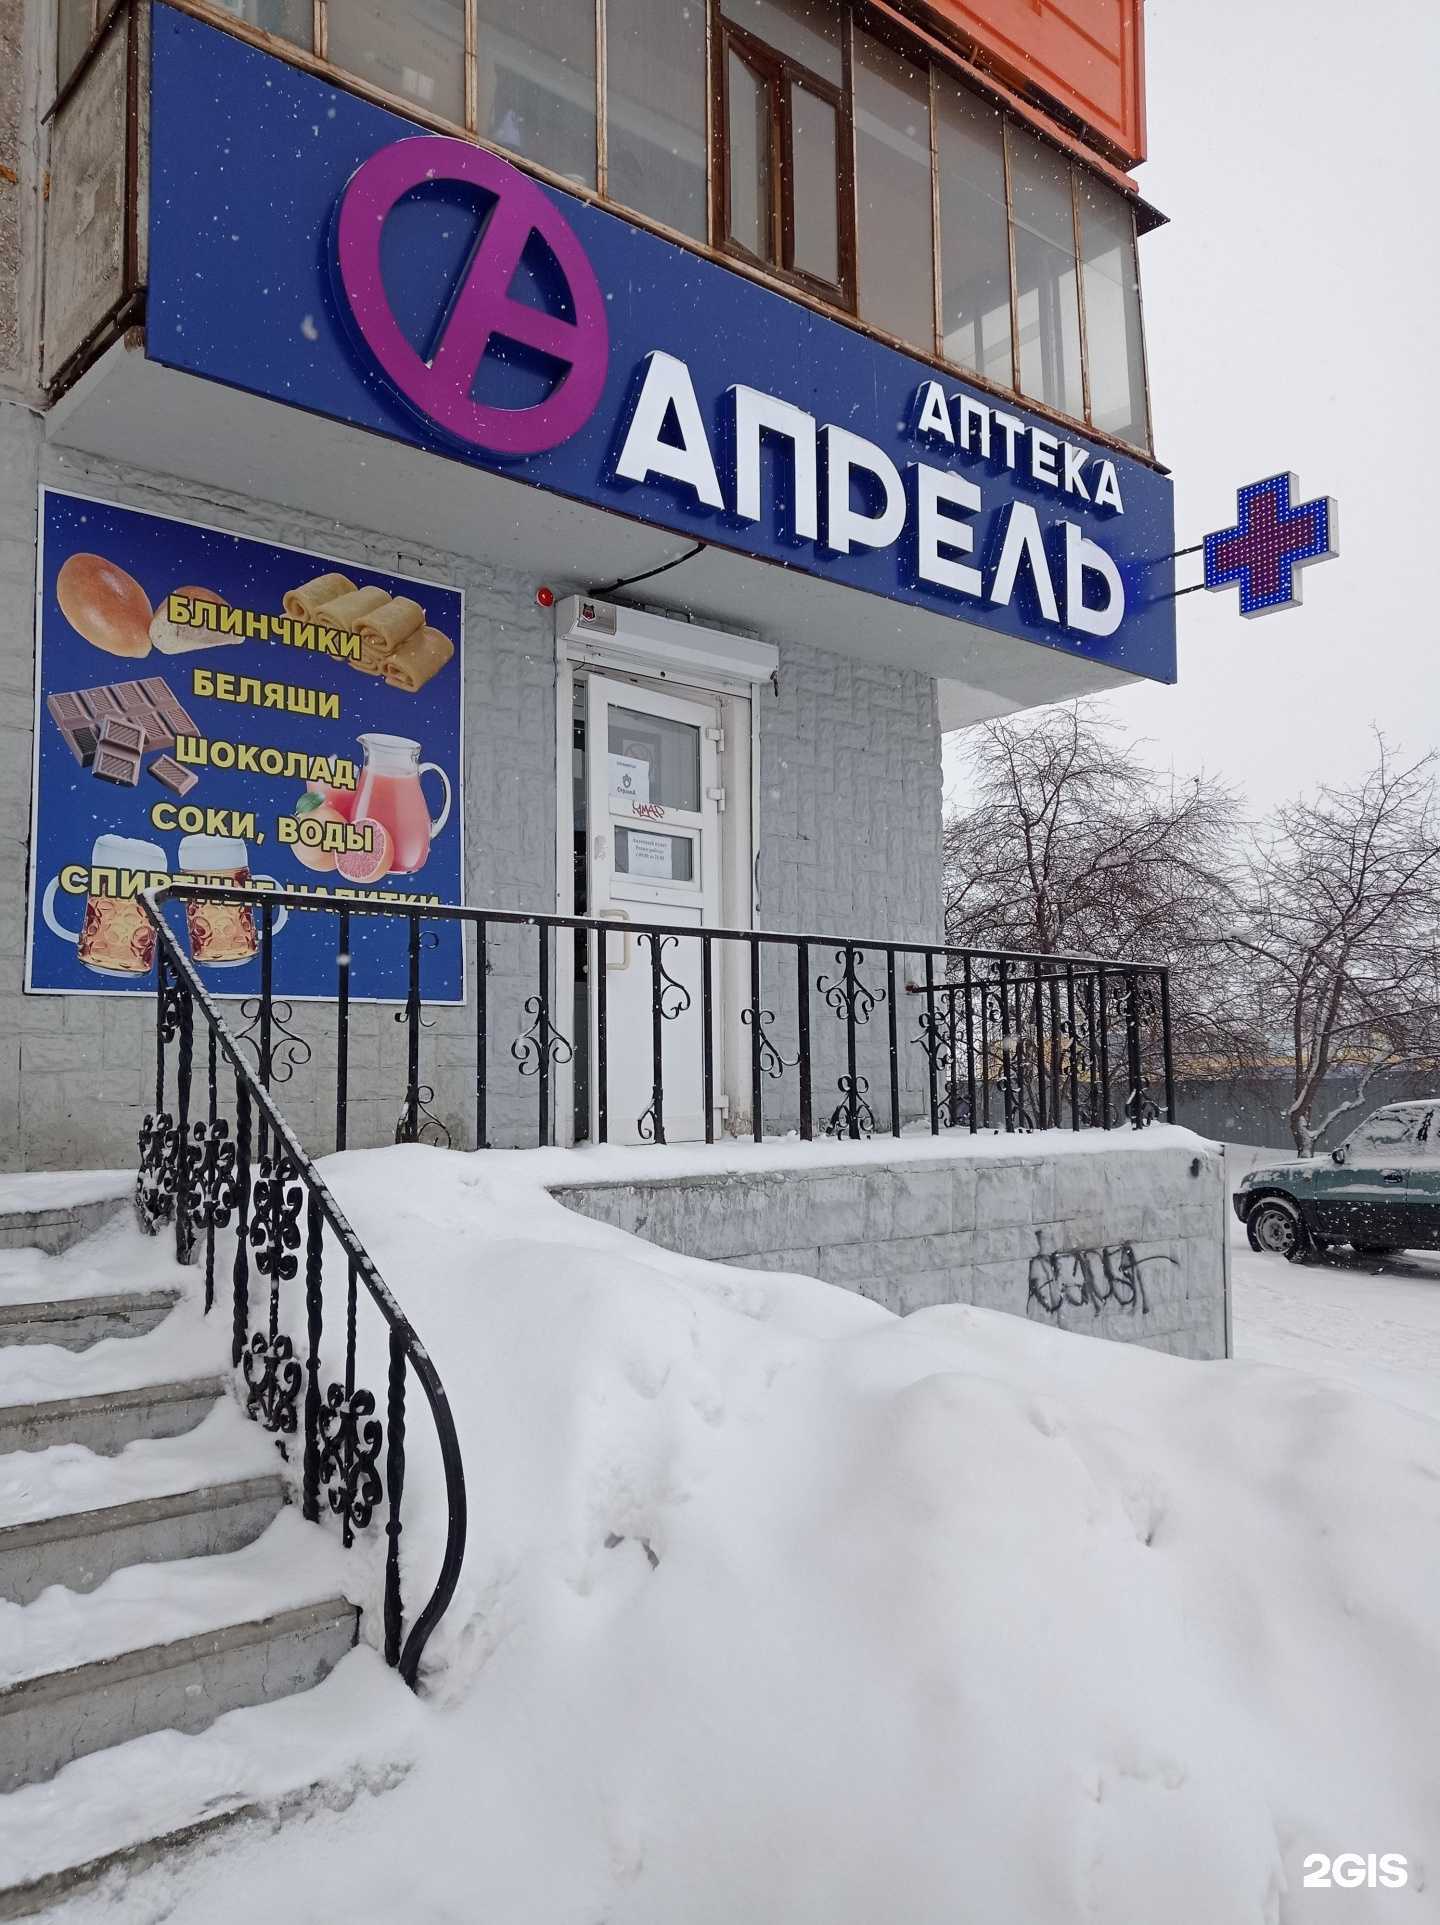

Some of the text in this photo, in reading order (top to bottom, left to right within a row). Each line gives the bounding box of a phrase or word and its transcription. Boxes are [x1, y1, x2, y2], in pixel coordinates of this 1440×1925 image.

[917, 380, 1125, 515] АПТЕКА
[614, 350, 1125, 637] АПРЕЛЬ
[168, 594, 362, 660] БЛИНЧИКИ
[192, 668, 340, 719] БЕЛЯШИ
[175, 735, 356, 790] ШОКОЛАД
[151, 803, 374, 853] СОКИ, ВОДЫ
